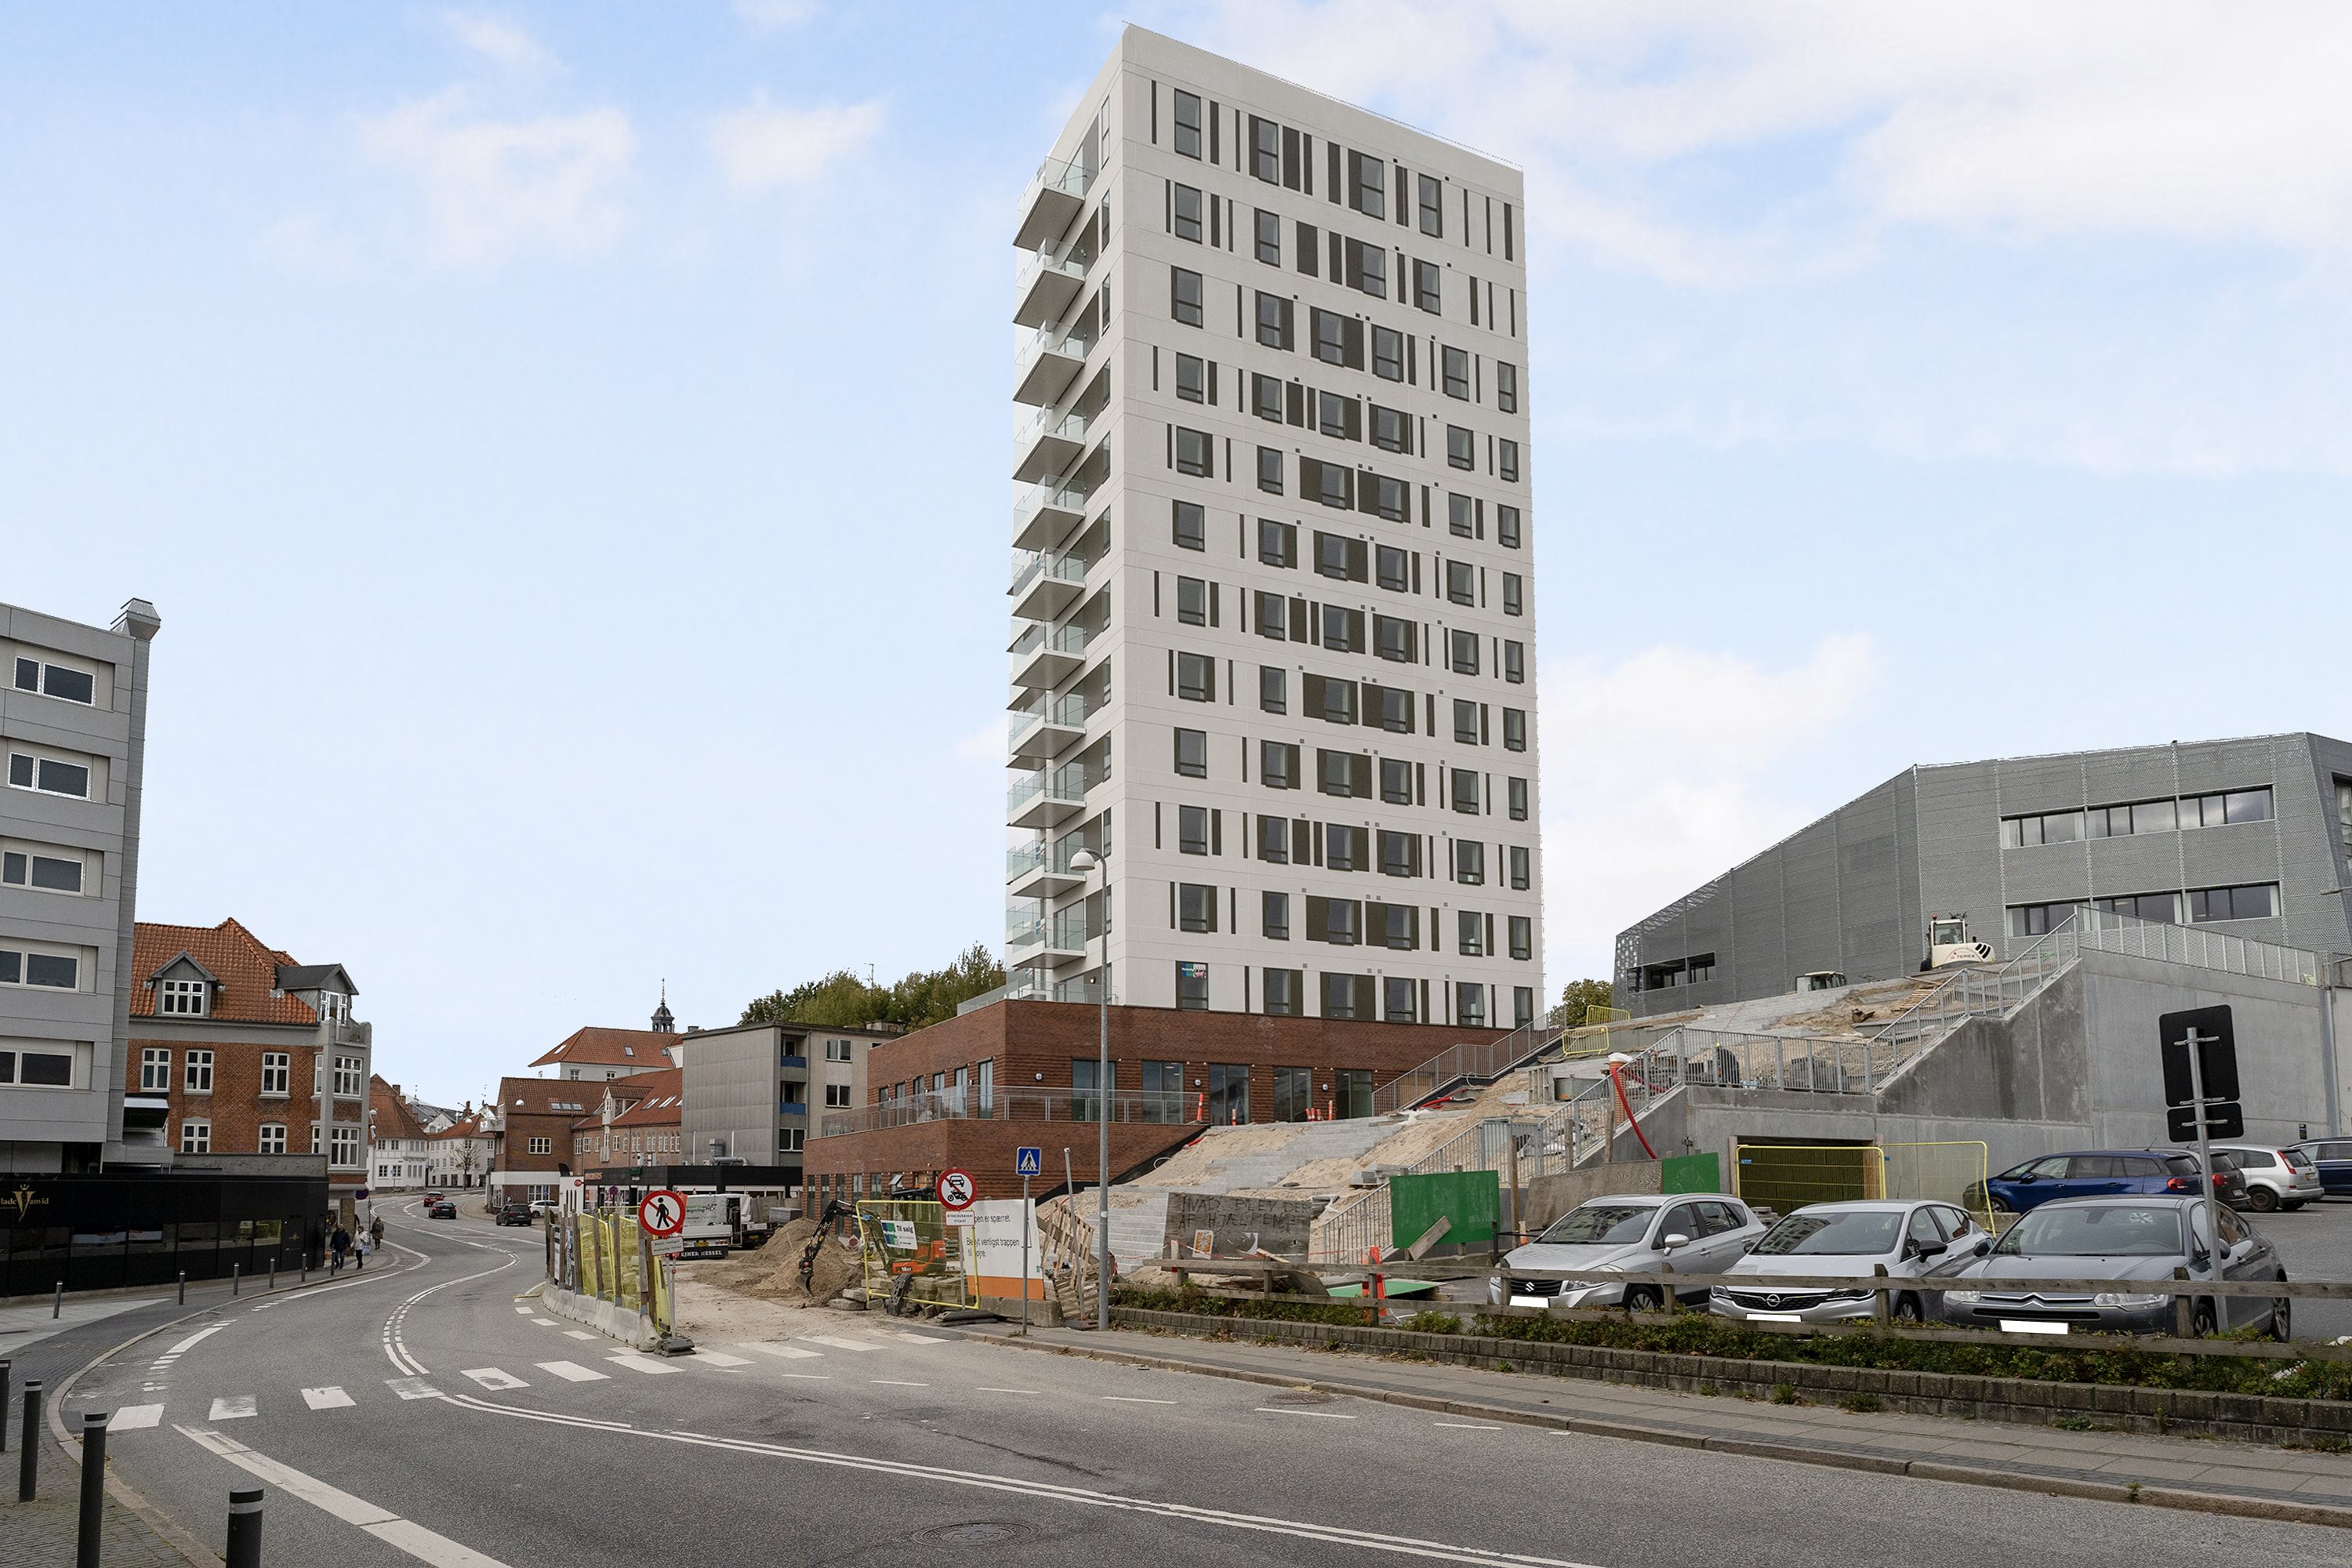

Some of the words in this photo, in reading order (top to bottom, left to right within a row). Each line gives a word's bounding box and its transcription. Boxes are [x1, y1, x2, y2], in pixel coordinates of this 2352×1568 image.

[1181, 1196, 1221, 1213] HVAD
[1283, 1201, 1312, 1217] DER
[1178, 1214, 1204, 1230] AF
[967, 1237, 981, 1247] Beyt
